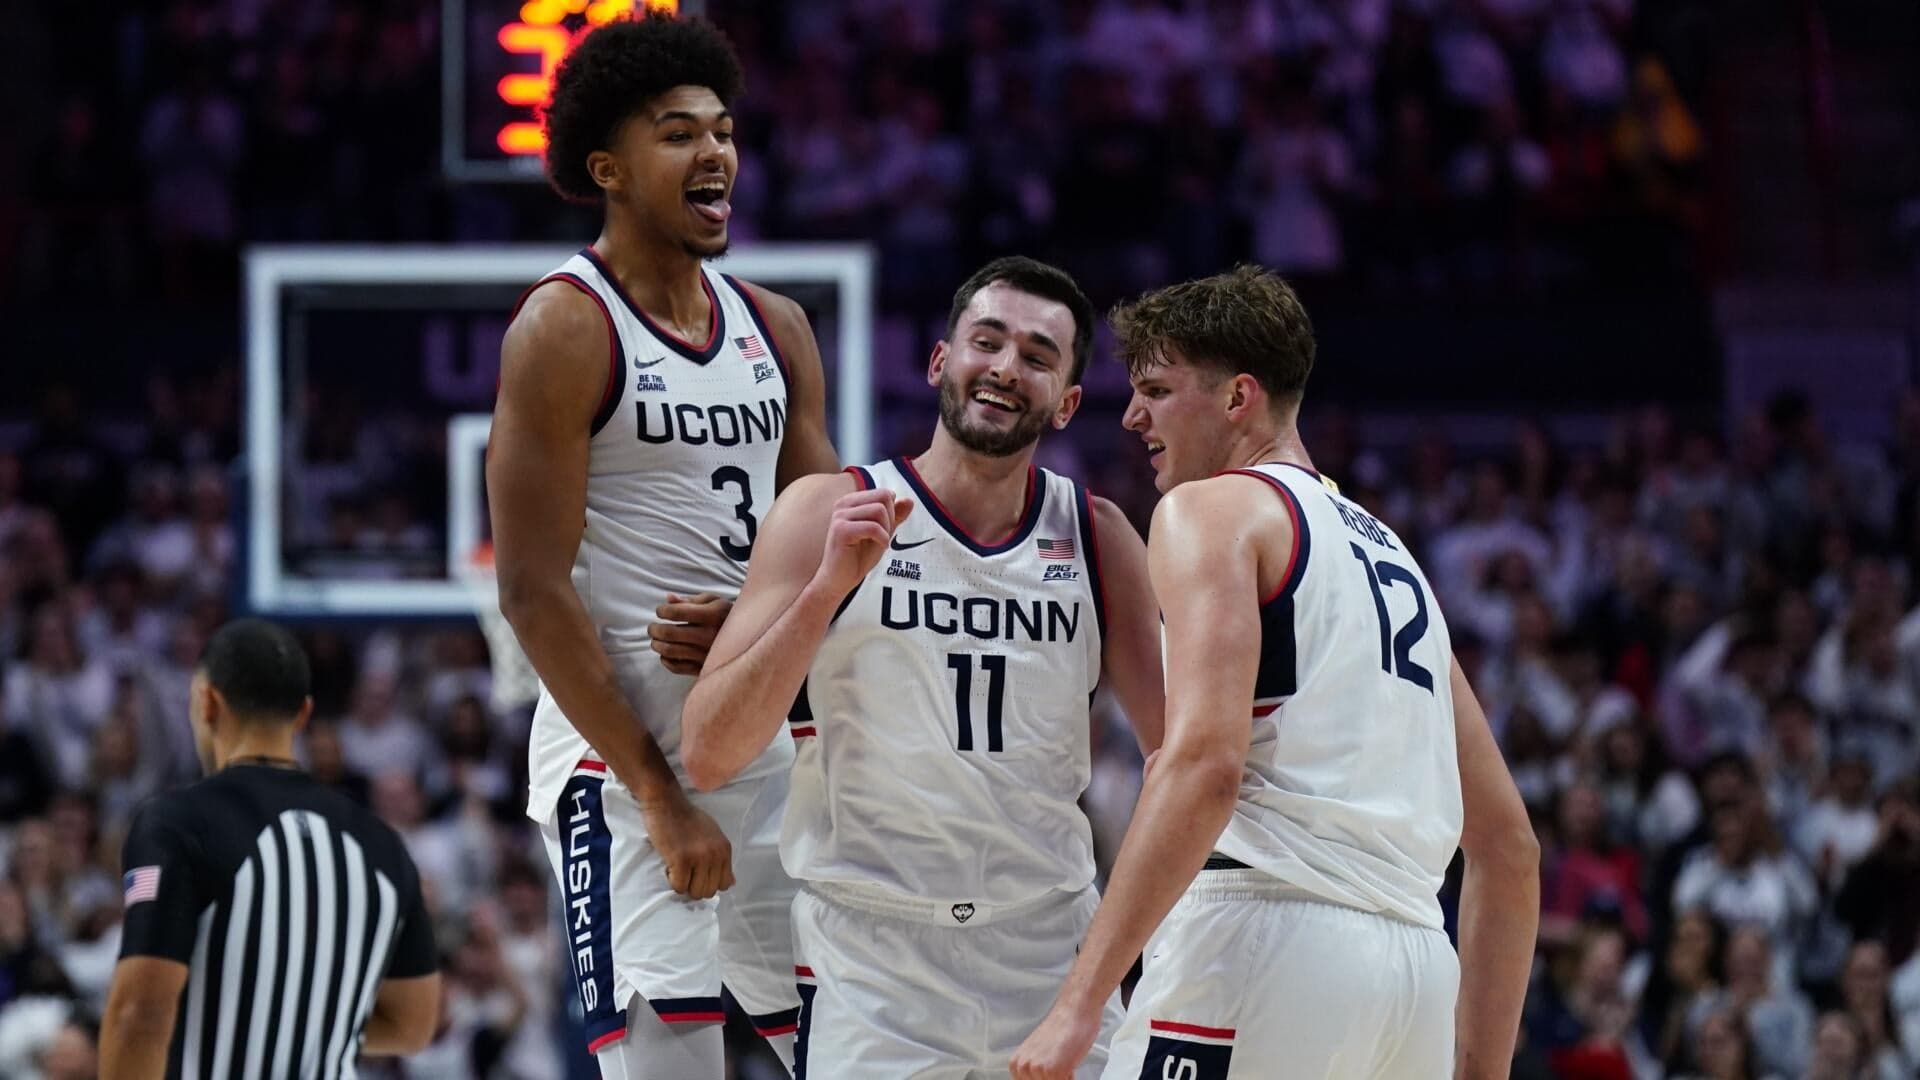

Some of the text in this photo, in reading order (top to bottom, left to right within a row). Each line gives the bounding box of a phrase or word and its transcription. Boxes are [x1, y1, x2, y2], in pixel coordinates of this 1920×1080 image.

[637, 382, 667, 391] CHANGE
[638, 374, 649, 382] BE
[636, 397, 786, 446] UCONN
[711, 465, 757, 561] 3
[1325, 493, 1398, 551] REIBE
[886, 567, 922, 580] CHANGE
[891, 559, 920, 571] BE THE
[1043, 571, 1079, 579] EAST
[1047, 564, 1072, 572] BIG
[881, 586, 1079, 643] UCONN
[1349, 541, 1434, 697] 12
[947, 653, 1006, 752] 11
[569, 788, 597, 1012] HUSKIES
